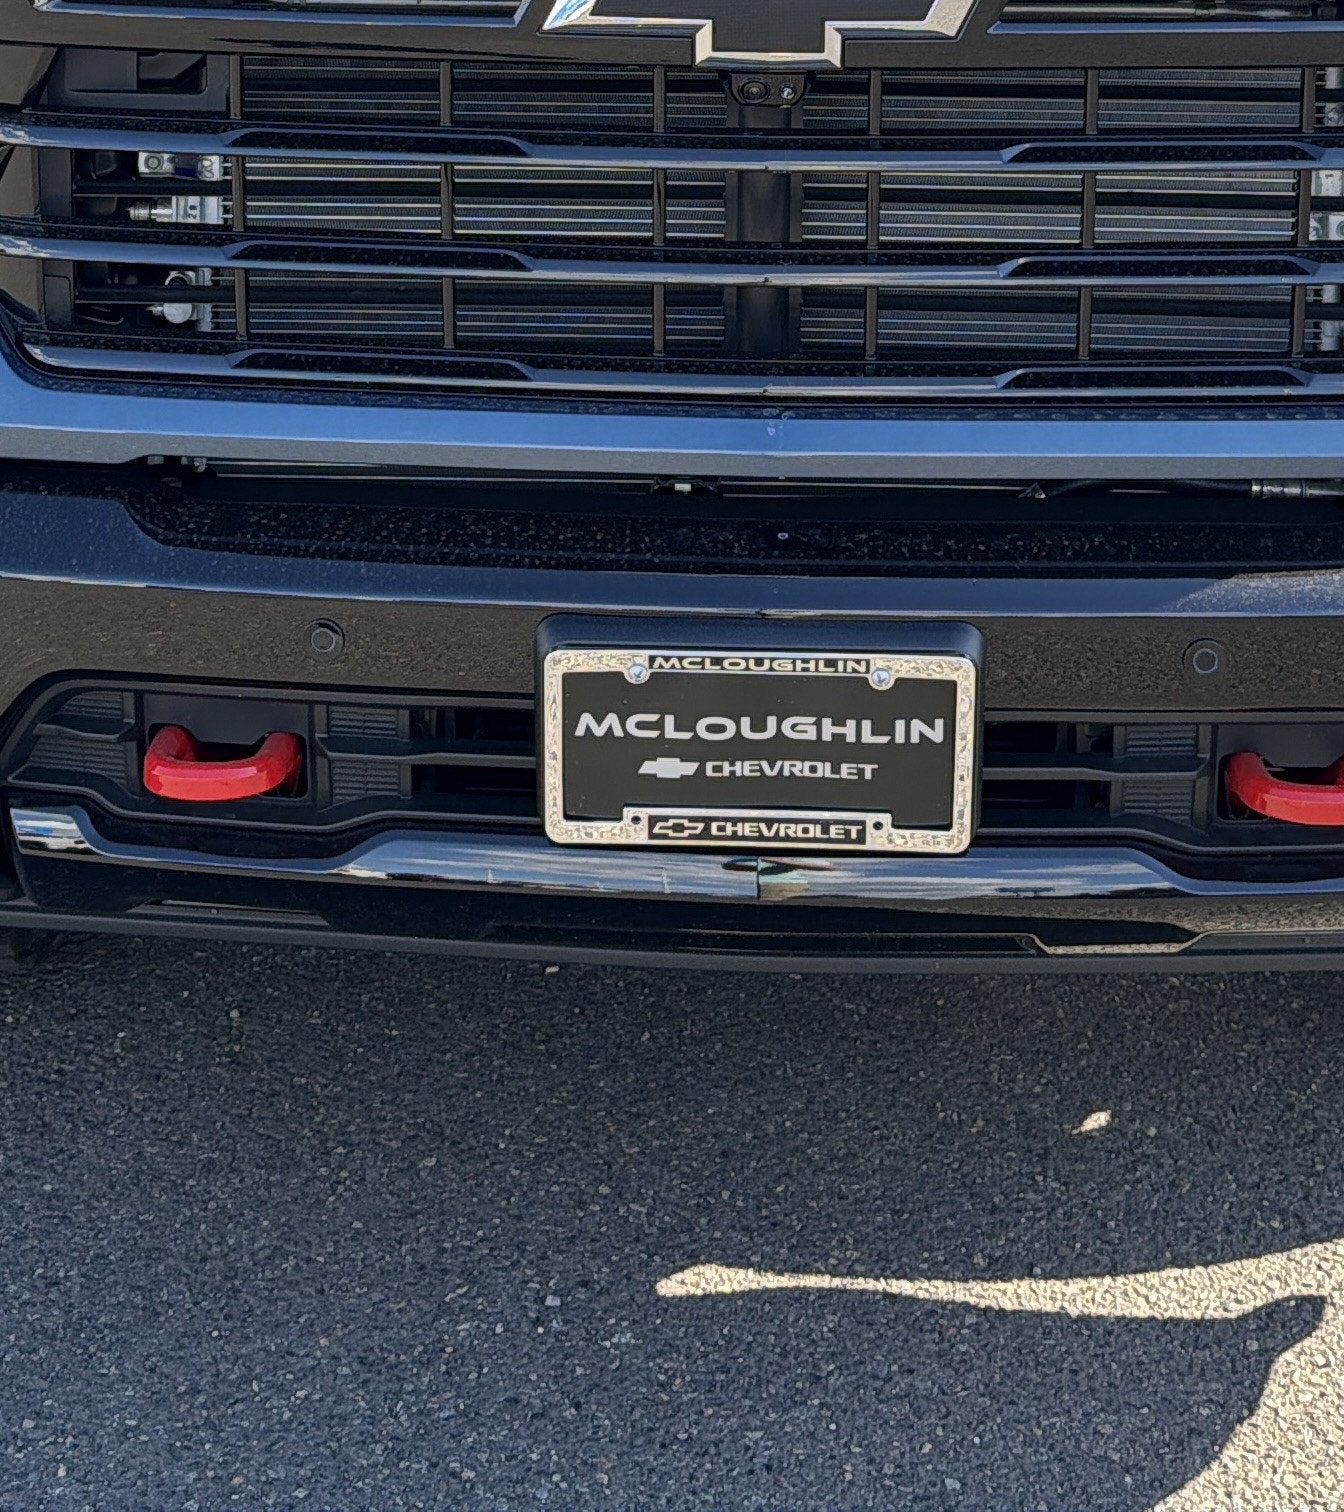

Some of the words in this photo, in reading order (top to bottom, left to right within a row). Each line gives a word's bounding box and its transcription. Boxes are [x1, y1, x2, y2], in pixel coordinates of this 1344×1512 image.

[652, 656, 869, 674] MCLOUGHLIN
[574, 712, 945, 744] MCLOUGHLIN
[705, 760, 879, 780] CHEVROLET
[710, 821, 863, 840] CHEVROLET
